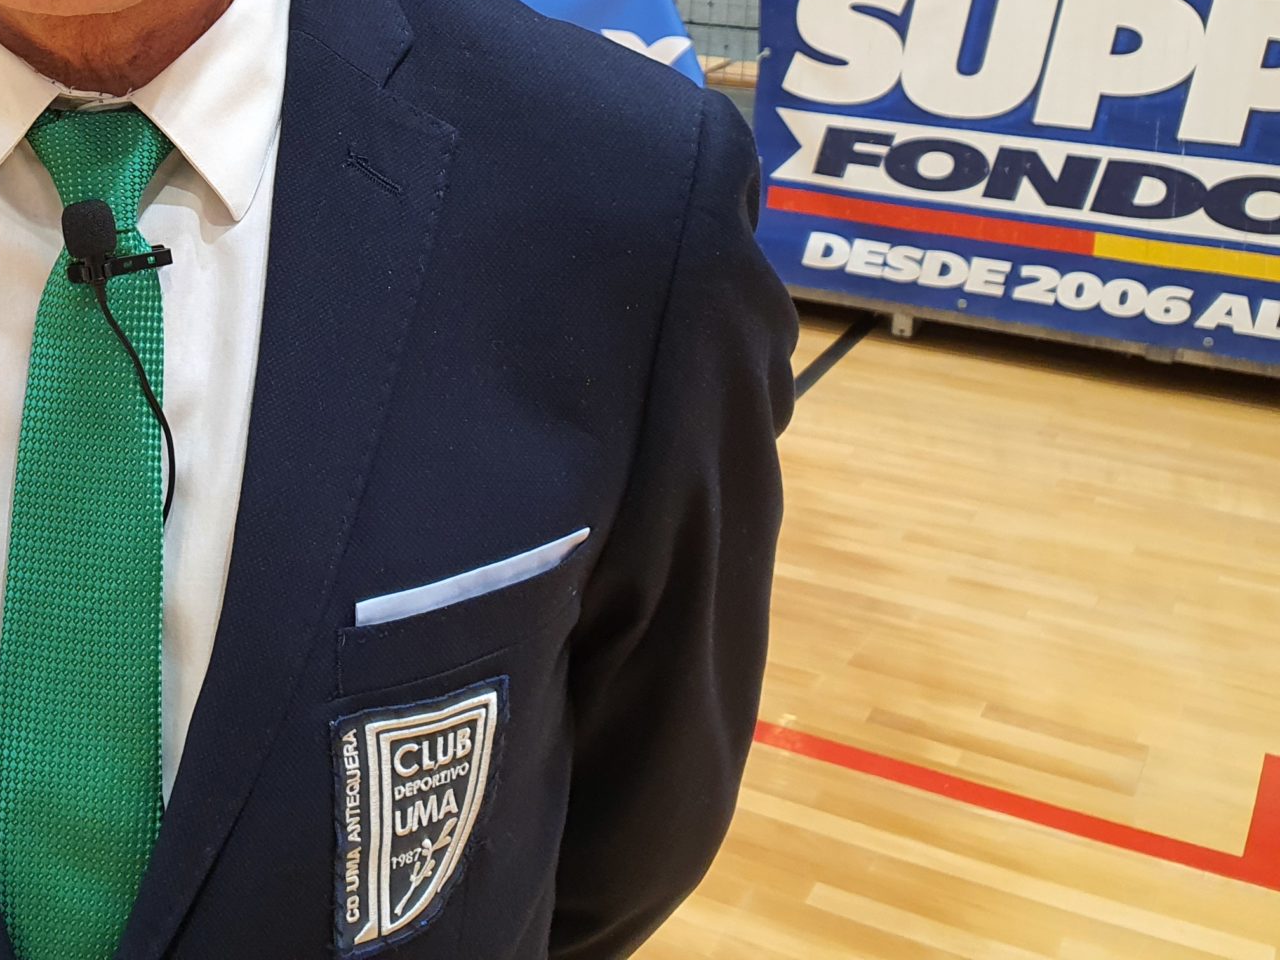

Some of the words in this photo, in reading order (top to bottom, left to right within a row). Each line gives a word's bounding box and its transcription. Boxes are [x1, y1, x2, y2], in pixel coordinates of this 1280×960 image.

[801, 231, 1012, 298] DESDE
[1012, 264, 1194, 325] 2006
[393, 727, 472, 778] CLUB
[342, 728, 363, 842] ANTEQUERA
[393, 761, 470, 801] DEPORTIVO
[394, 788, 460, 837] UMA
[346, 846, 362, 892] UMA
[391, 847, 421, 869] 1987
[345, 895, 360, 924] CD
